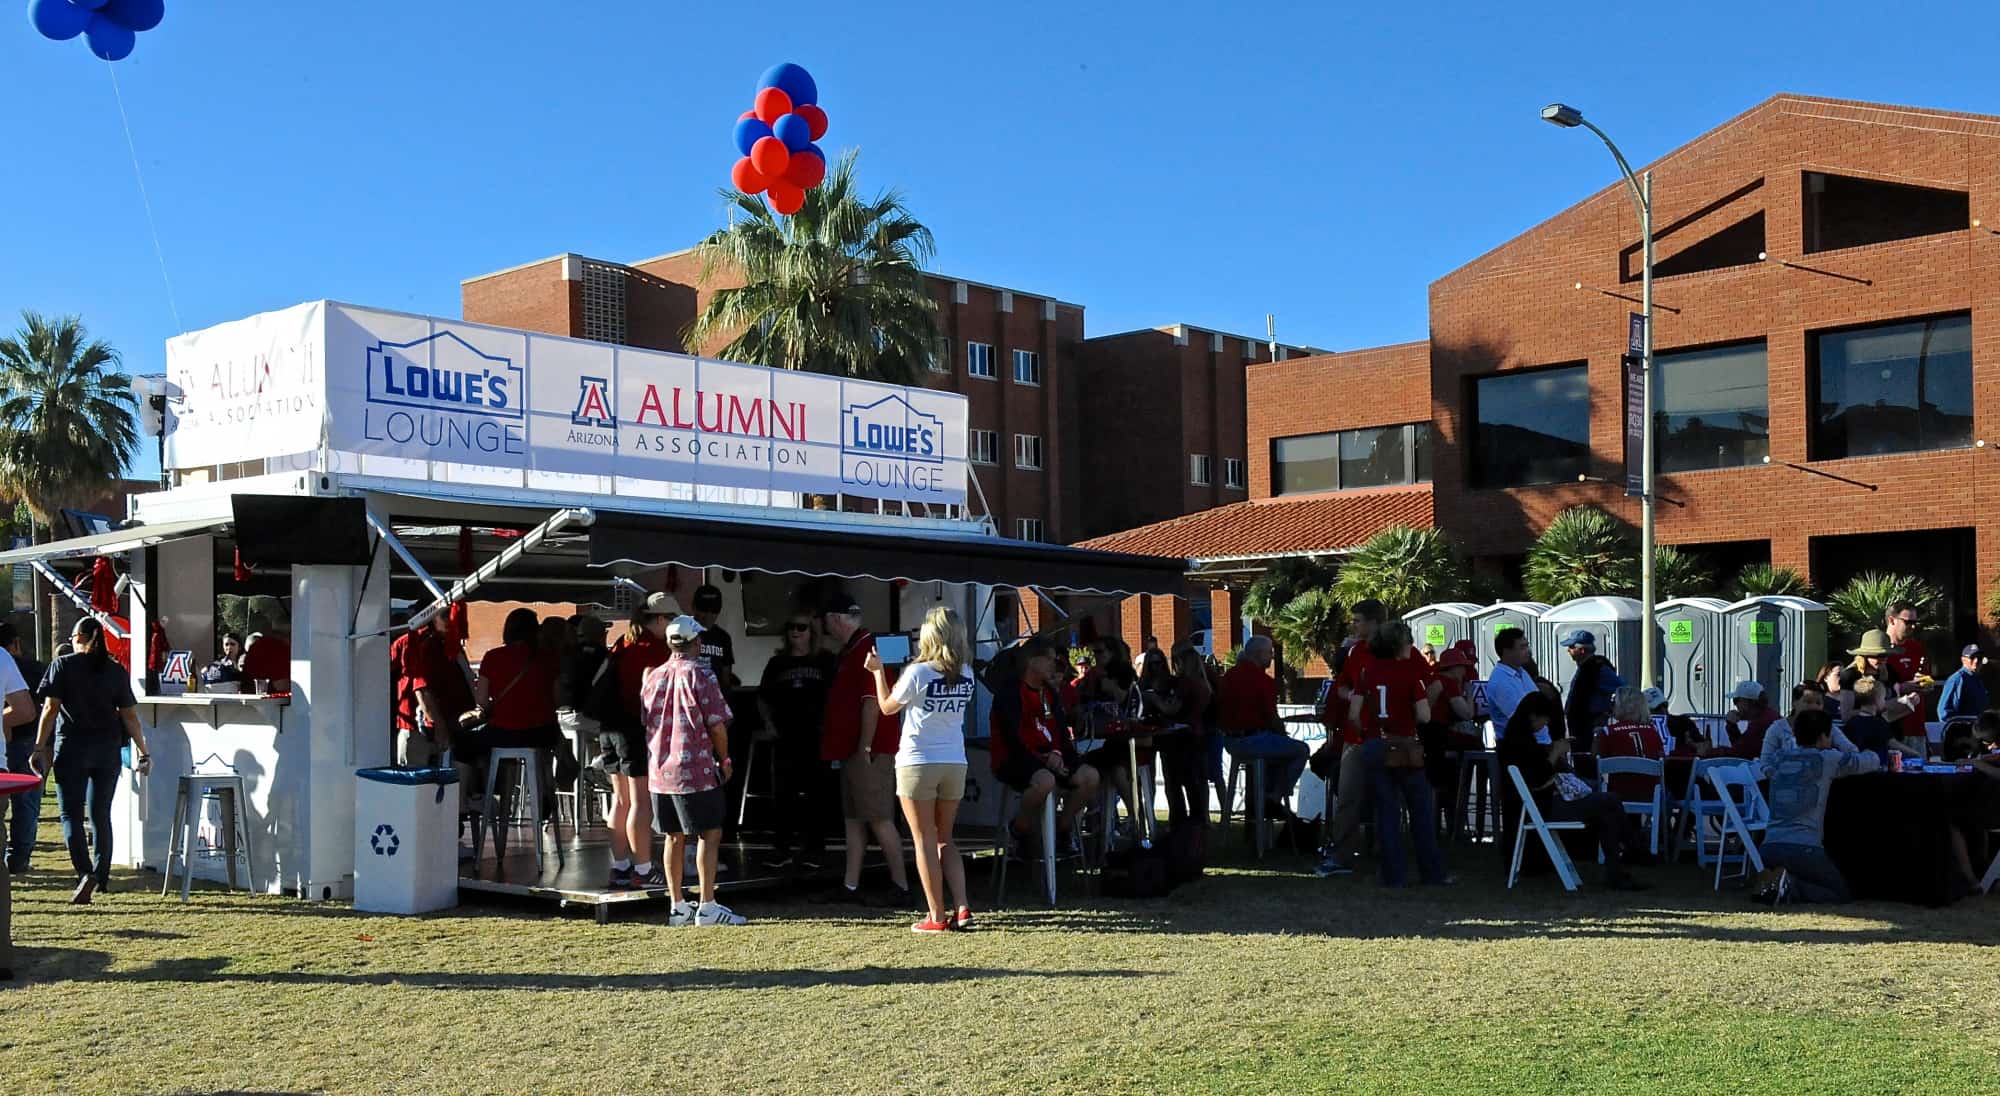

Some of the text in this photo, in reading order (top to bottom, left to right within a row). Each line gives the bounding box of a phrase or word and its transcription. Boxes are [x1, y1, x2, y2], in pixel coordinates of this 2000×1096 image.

[384, 356, 508, 409] LOWE'S
[571, 376, 617, 429] A
[637, 384, 806, 442] ALUMNI
[365, 408, 524, 455] LOUNGE
[567, 429, 619, 447] ARIZONA
[853, 416, 934, 456] LOWE'S
[635, 433, 807, 465] ASSOCIATION
[842, 461, 944, 492] LOUNGE
[159, 650, 192, 684] A
[922, 699, 967, 713] STAF
[1376, 685, 1389, 718] 1
